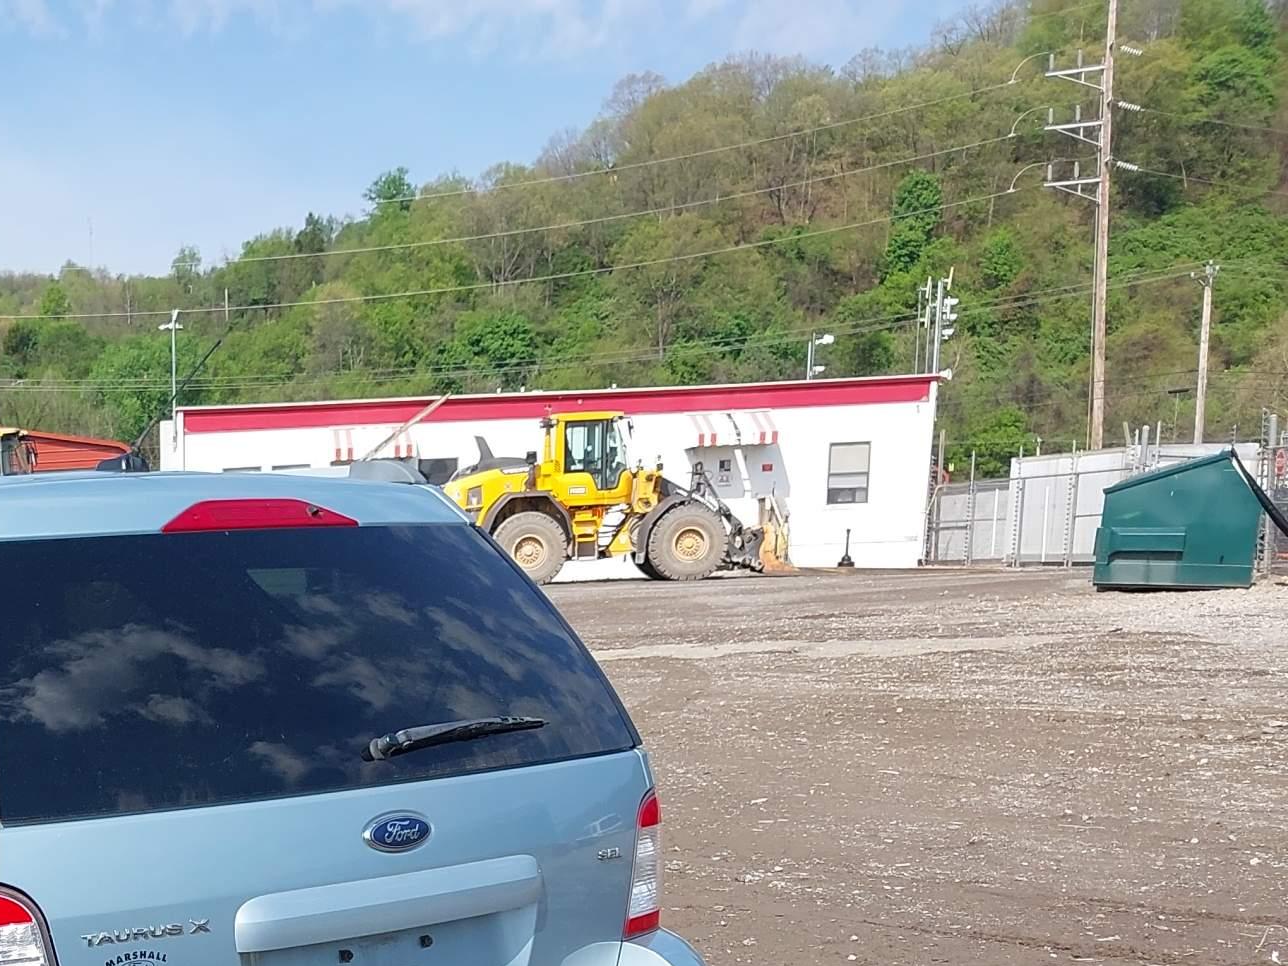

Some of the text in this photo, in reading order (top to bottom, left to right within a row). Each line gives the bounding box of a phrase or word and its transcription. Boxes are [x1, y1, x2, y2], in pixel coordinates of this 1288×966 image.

[384, 820, 420, 843] Ford
[597, 847, 621, 861] SEL
[80, 918, 211, 947] TAURUS X
